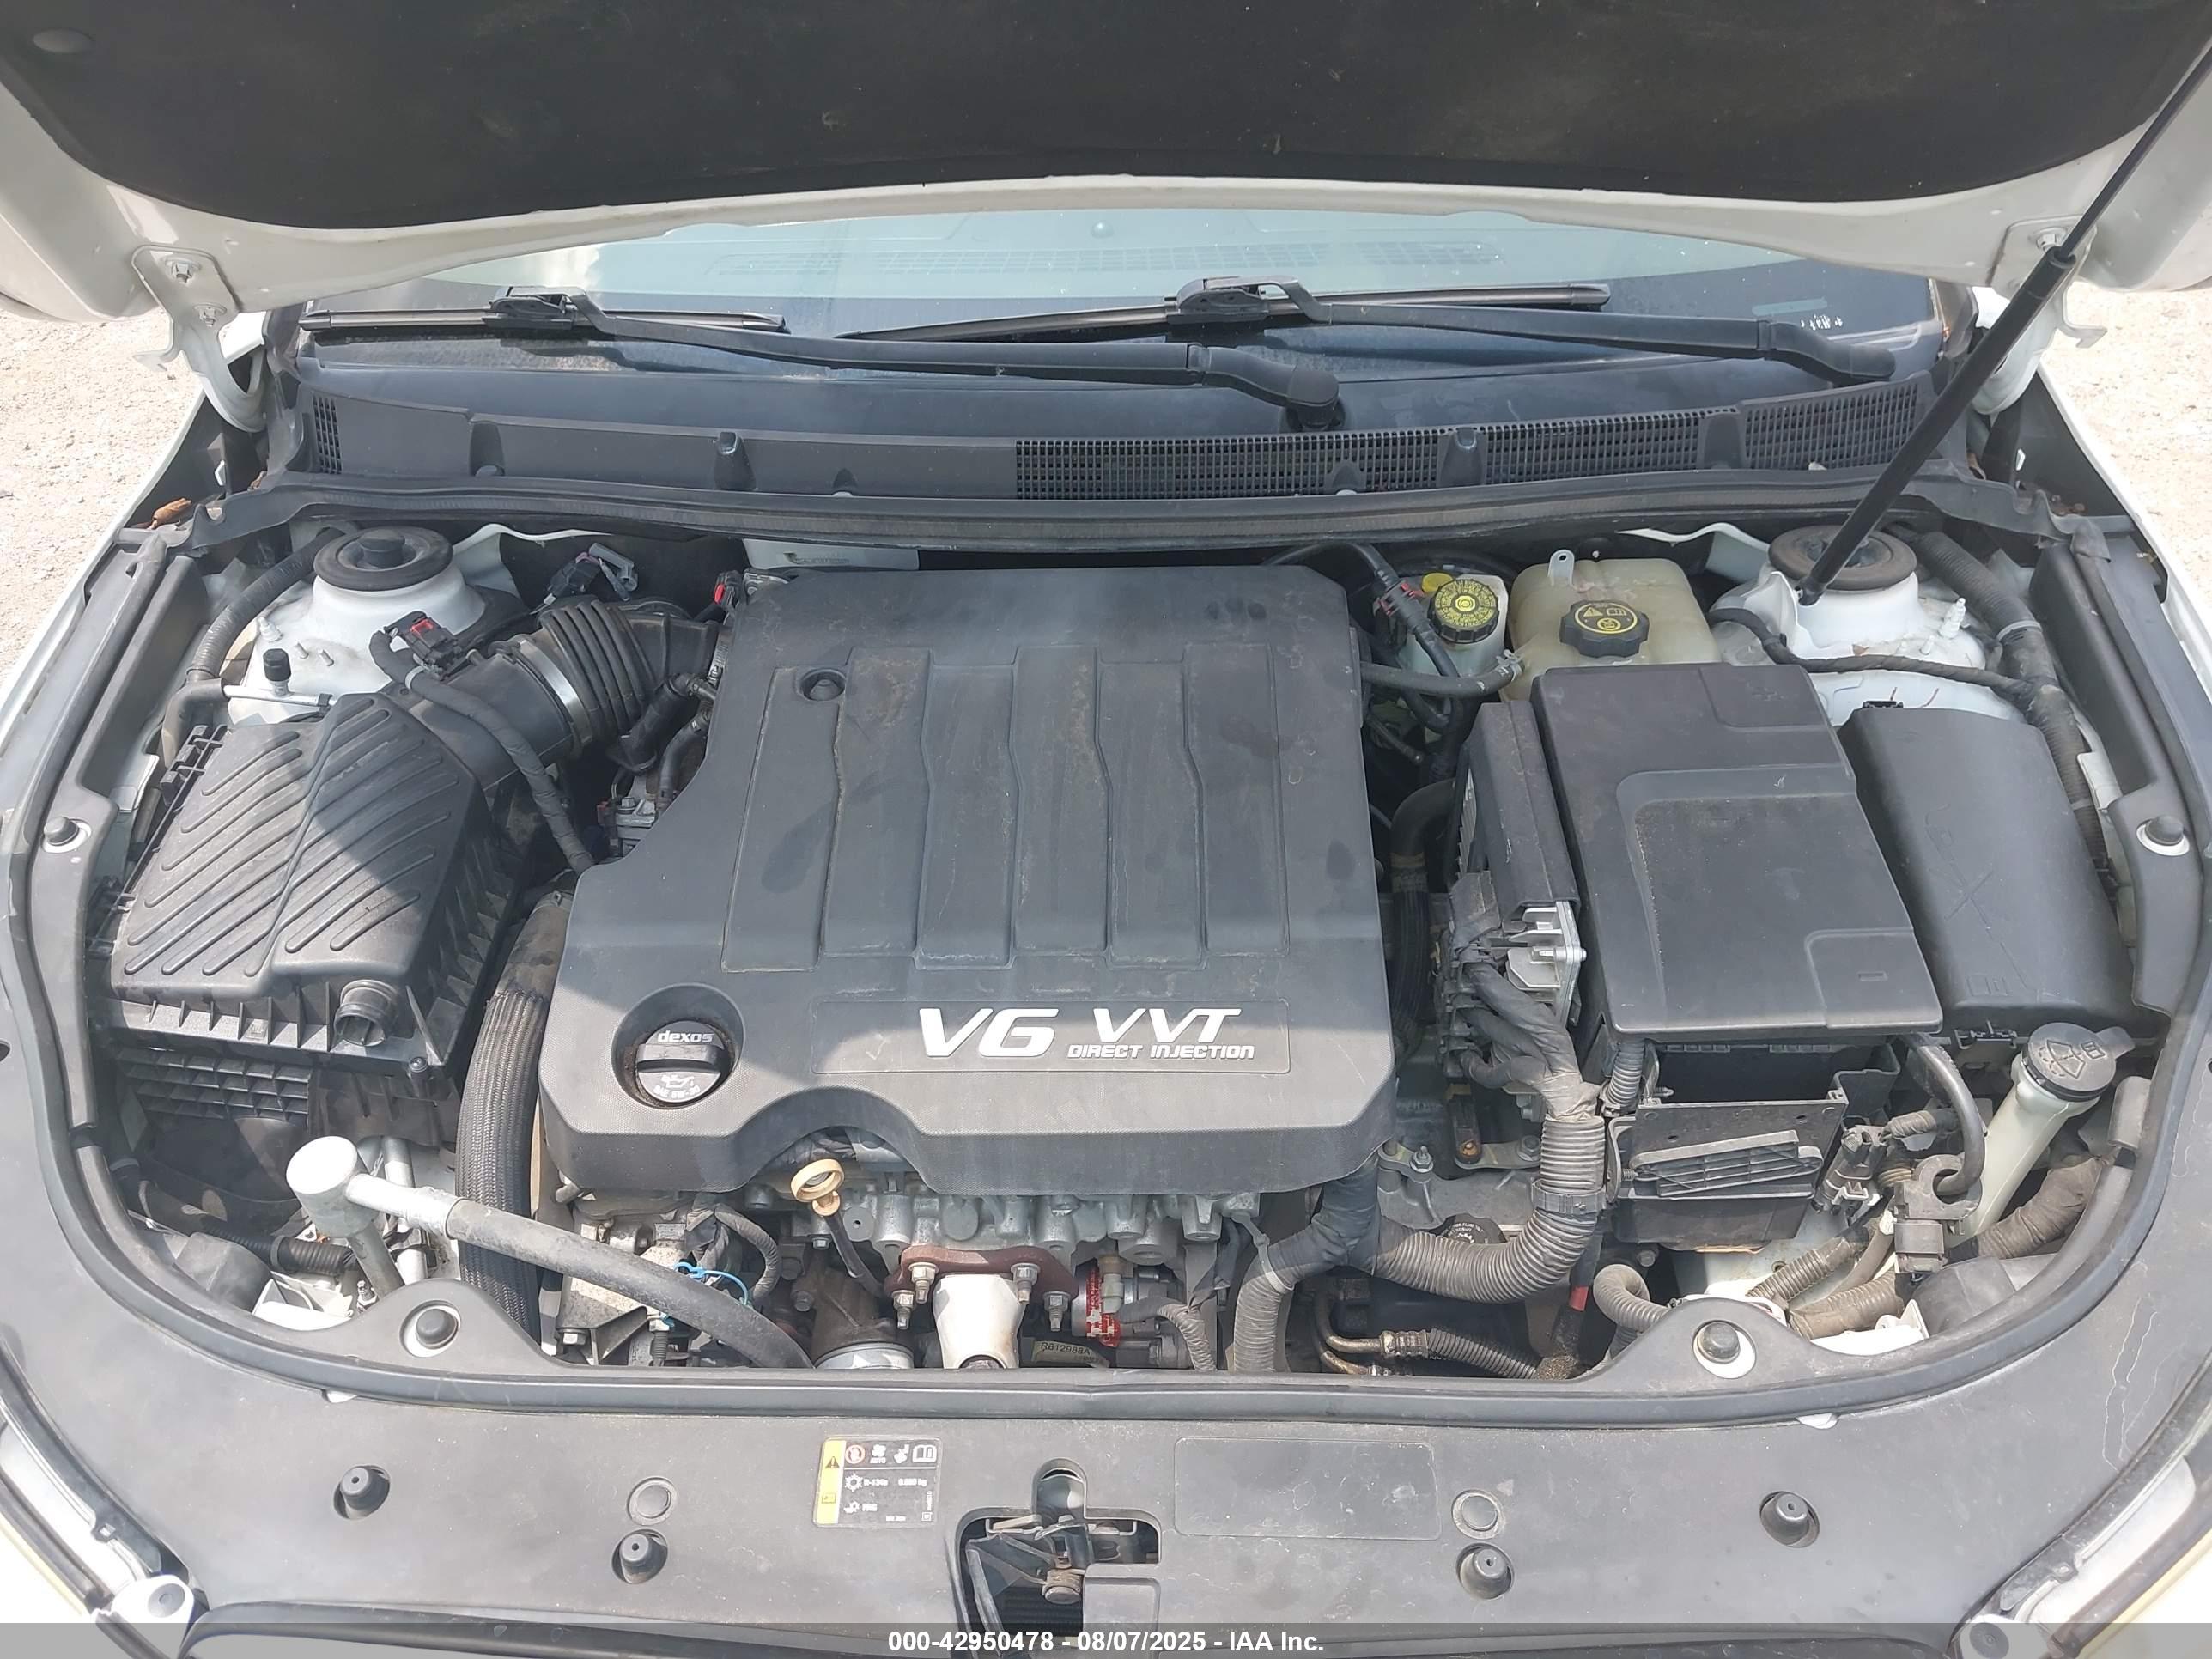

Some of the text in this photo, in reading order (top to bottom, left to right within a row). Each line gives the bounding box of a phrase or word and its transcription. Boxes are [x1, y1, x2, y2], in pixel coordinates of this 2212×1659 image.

[657, 1030, 714, 1042] dexos
[919, 1008, 1243, 1058] V6 VVT
[1067, 1044, 1255, 1060] DIRECT INJECTION
